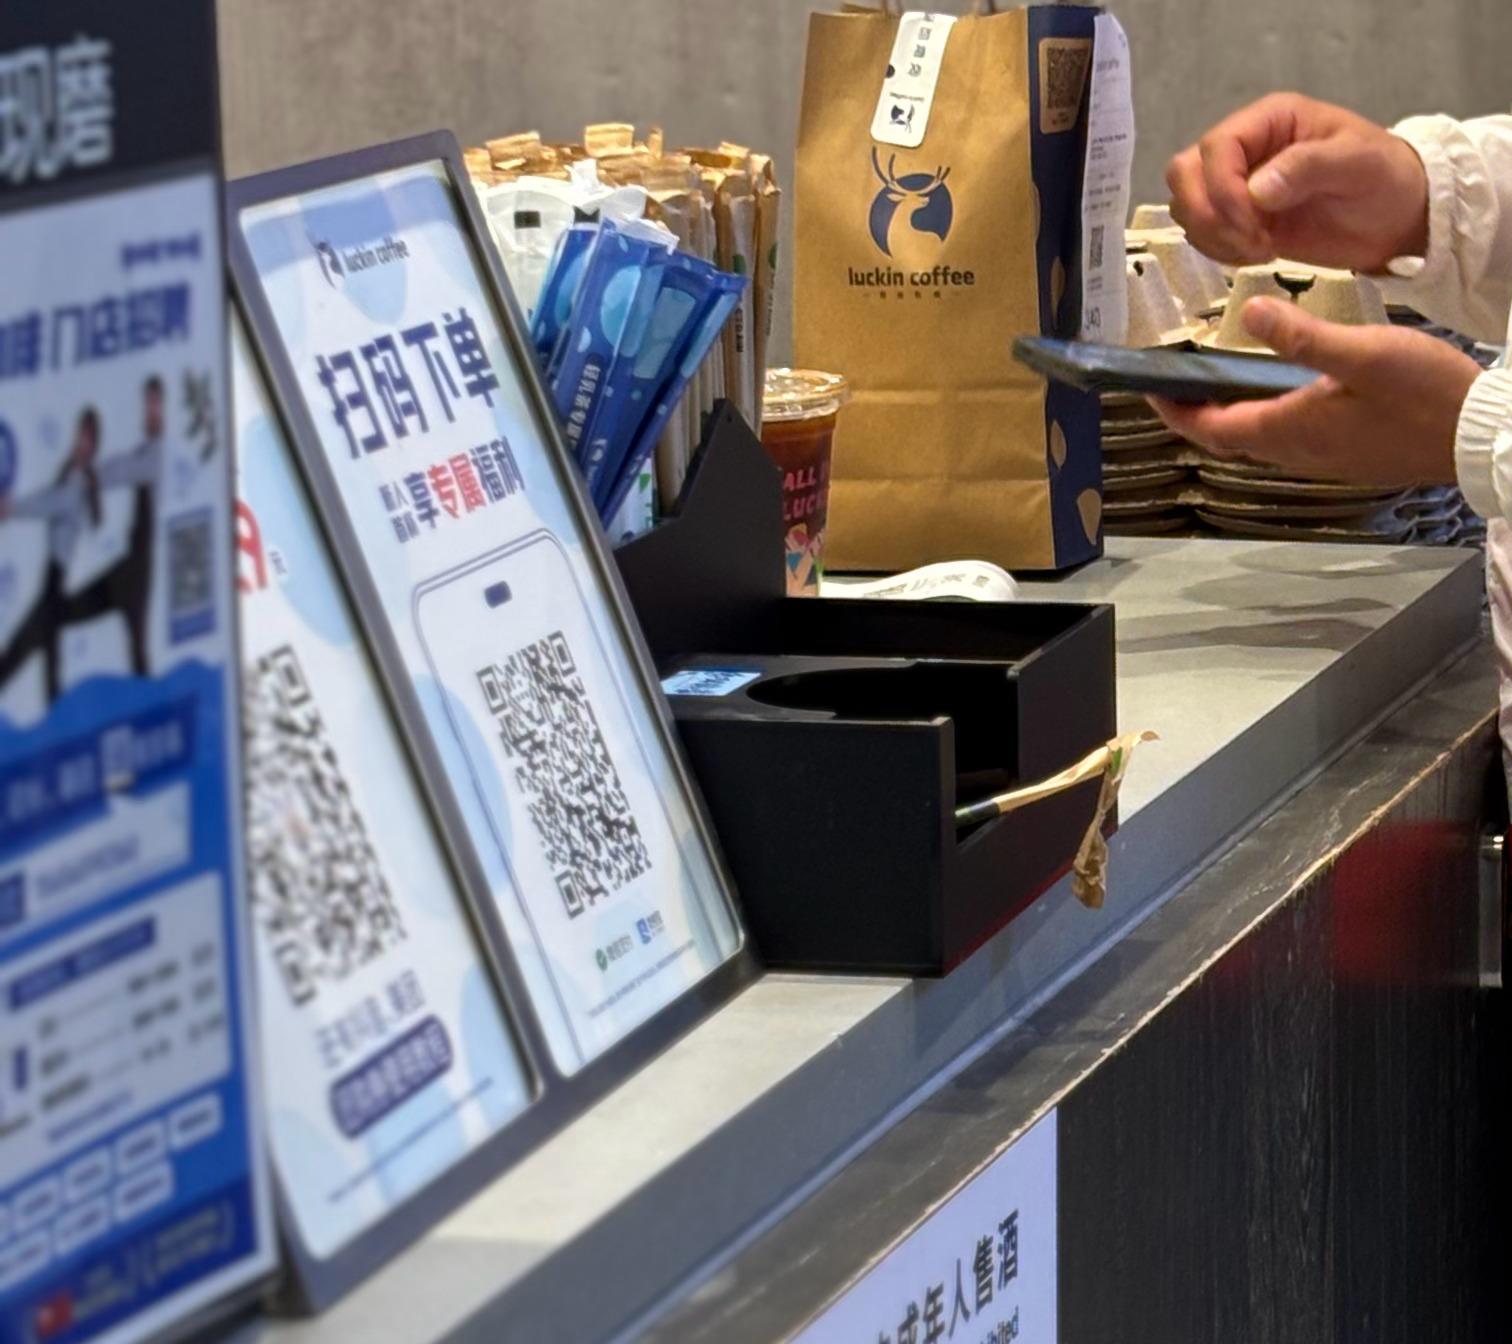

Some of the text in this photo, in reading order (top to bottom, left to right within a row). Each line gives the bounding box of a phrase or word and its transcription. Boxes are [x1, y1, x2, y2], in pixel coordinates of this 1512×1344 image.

[848, 265, 975, 286] luckin coffee
[315, 307, 499, 459] 扫码下单
